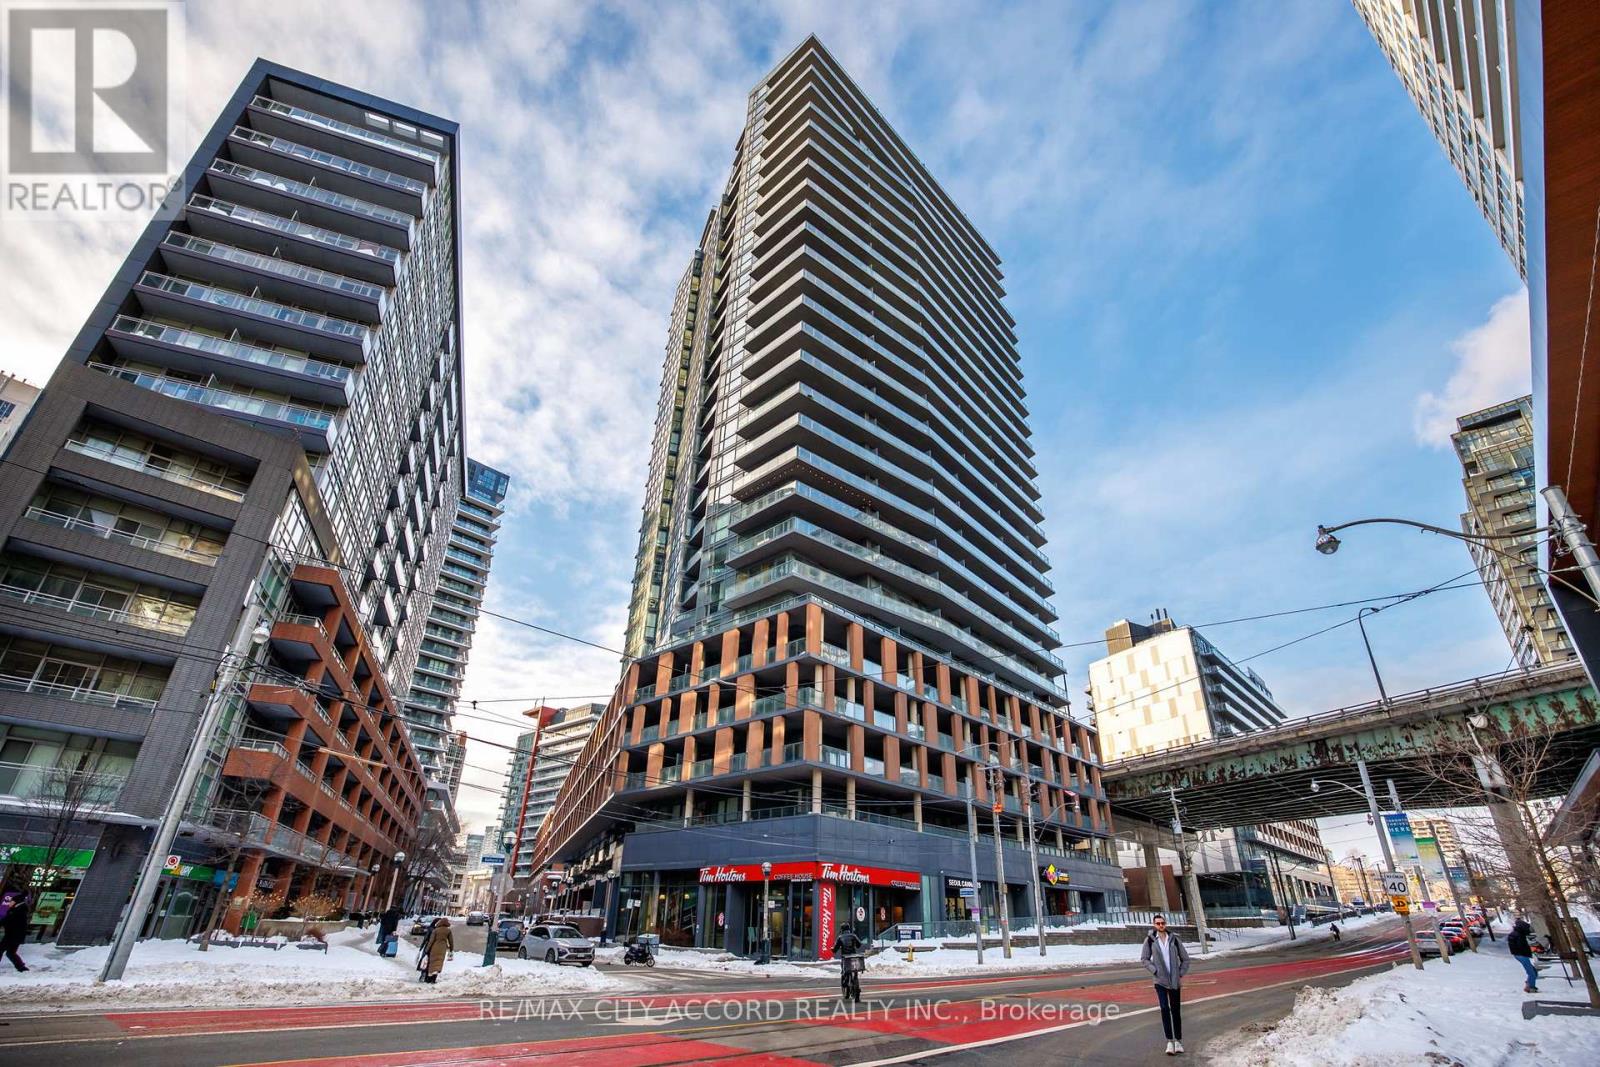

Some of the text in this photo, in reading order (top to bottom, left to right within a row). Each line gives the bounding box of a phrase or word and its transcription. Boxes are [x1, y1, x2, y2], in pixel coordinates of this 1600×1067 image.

[699, 866, 747, 883] Tim Hortons
[821, 863, 870, 884] Tim Hortons
[948, 879, 961, 887] SEOUL
[1389, 881, 1406, 892] 40
[822, 887, 832, 952] Tim Hortons
